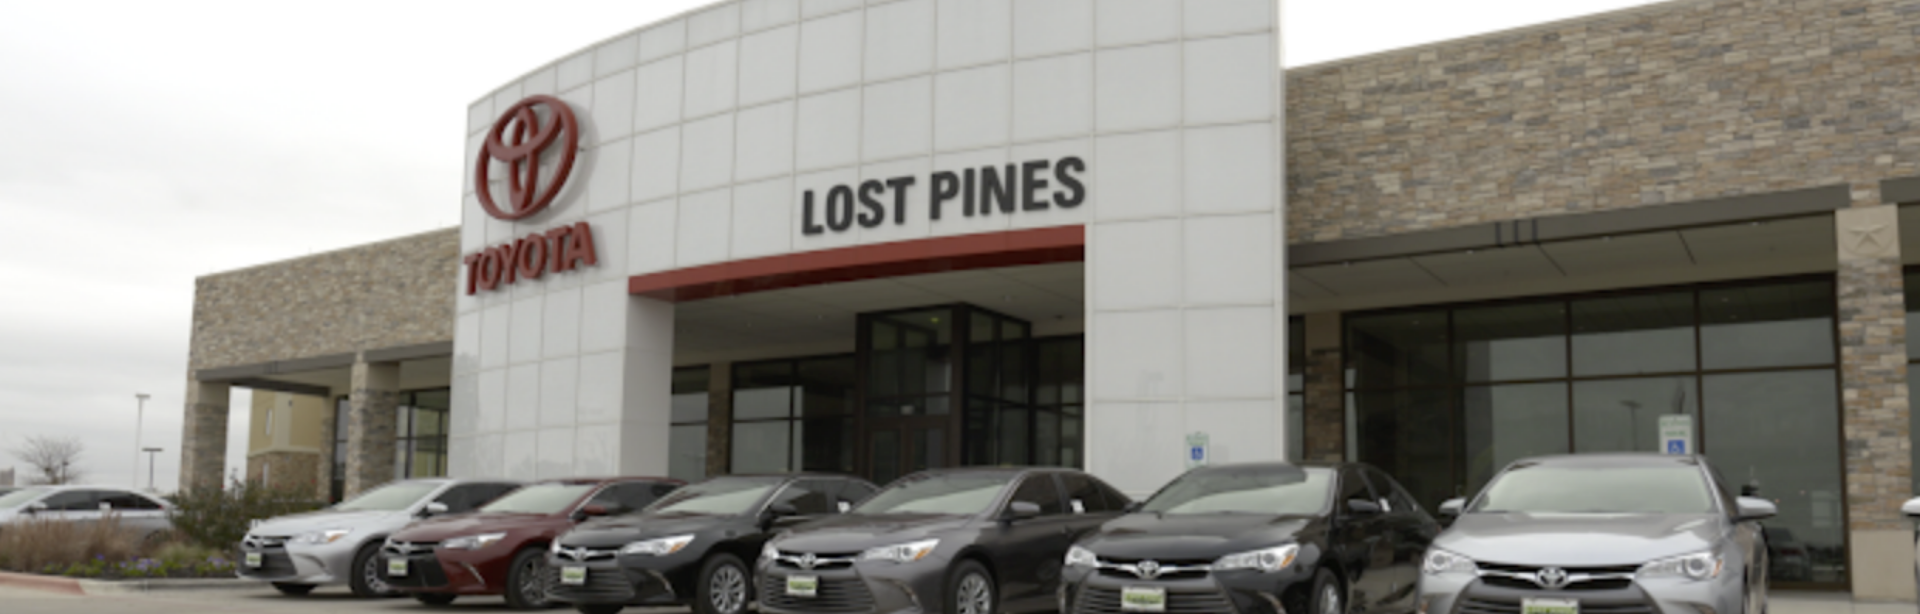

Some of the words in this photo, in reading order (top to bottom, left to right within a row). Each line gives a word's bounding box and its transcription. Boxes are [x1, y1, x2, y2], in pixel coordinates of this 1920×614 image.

[802, 176, 915, 236] LOST
[929, 156, 1086, 220] PINES
[463, 221, 597, 296] TOYOTA
